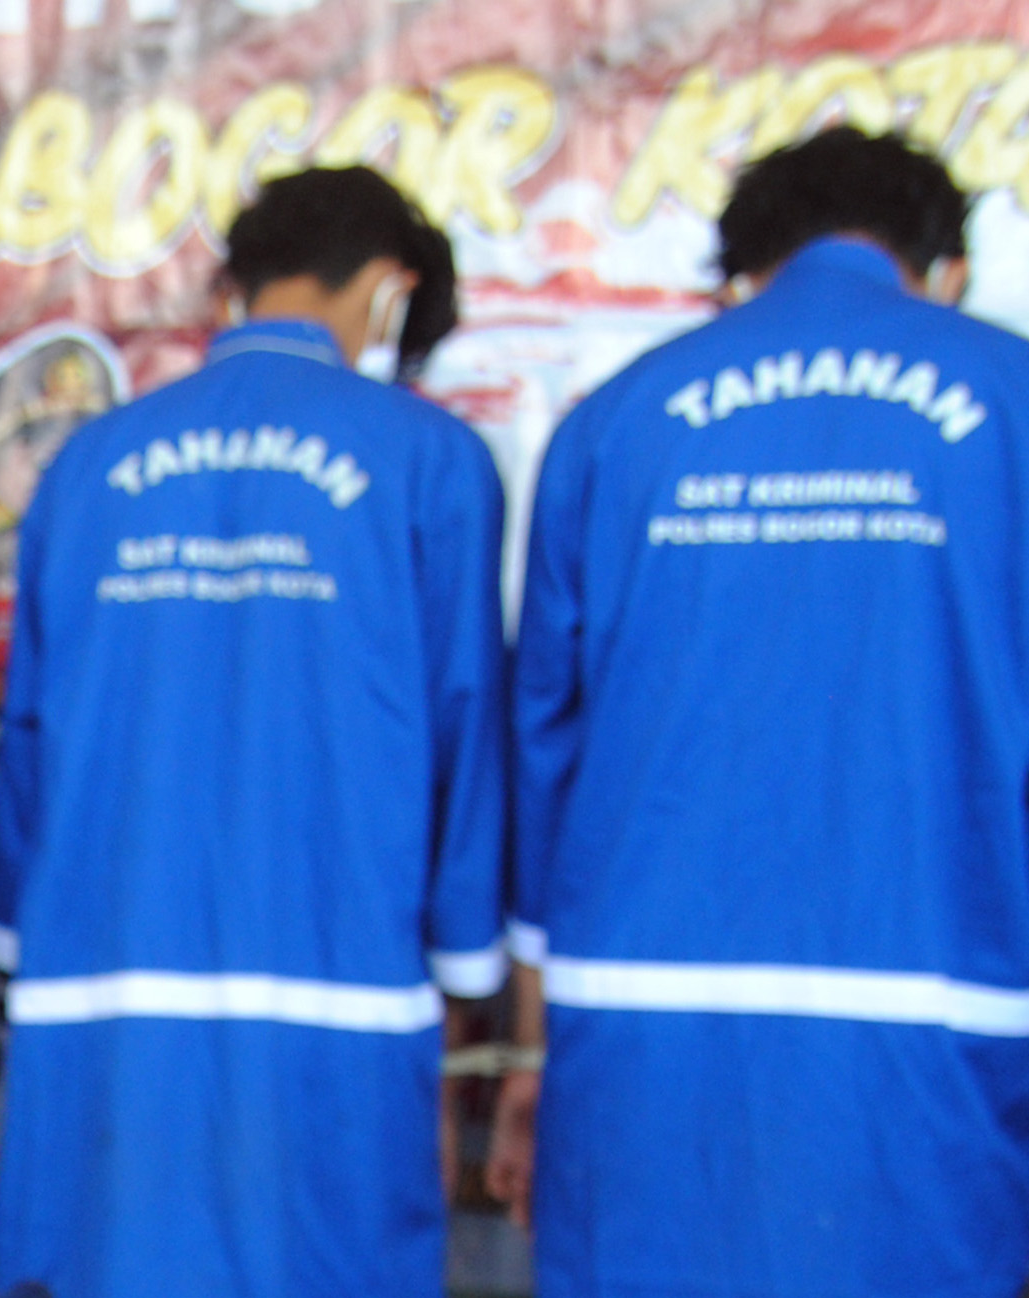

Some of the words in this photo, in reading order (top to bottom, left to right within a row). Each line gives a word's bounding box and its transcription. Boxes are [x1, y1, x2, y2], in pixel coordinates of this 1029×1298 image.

[664, 347, 988, 443] TAHANAN
[106, 423, 371, 510] TAHANAN
[675, 474, 747, 509] SAT
[748, 469, 921, 507] KRIMINAL
[647, 512, 758, 545] POLRES
[759, 510, 864, 543] BOGOR
[865, 510, 947, 547] KOTA
